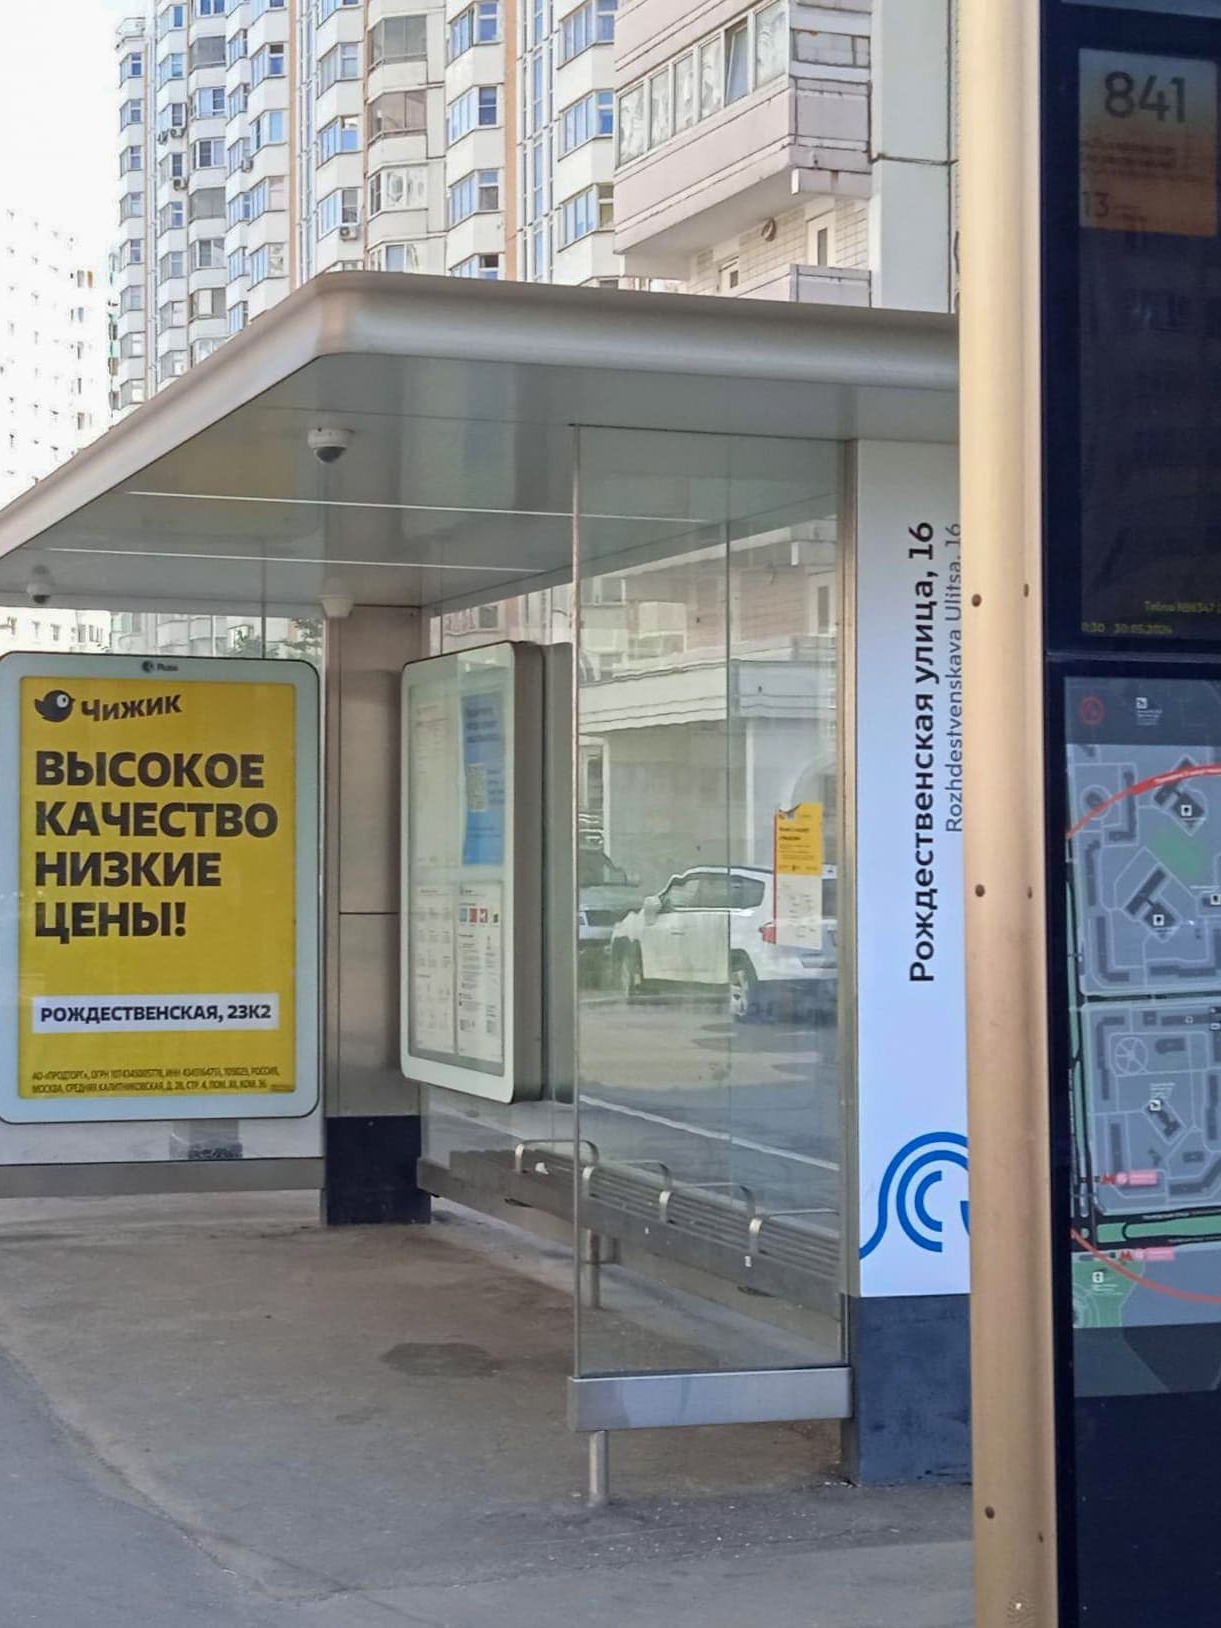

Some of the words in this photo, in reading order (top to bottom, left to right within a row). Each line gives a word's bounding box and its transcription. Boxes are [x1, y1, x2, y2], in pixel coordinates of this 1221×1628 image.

[1104, 71, 1186, 124] 841
[1082, 191, 1110, 218] 13
[909, 522, 934, 560] 16
[945, 523, 961, 548] 16
[915, 571, 940, 684] улица,
[36, 751, 265, 788] ВЫСОКОЕ
[35, 801, 279, 838] КАЧЕСТВО
[910, 693, 938, 982] Рождественская
[35, 851, 222, 887] НИЗКИЕ
[35, 902, 187, 944] ЦЕНЫ!
[41, 1005, 224, 1024] РОЖДЕСТВЕНСКАЯ,
